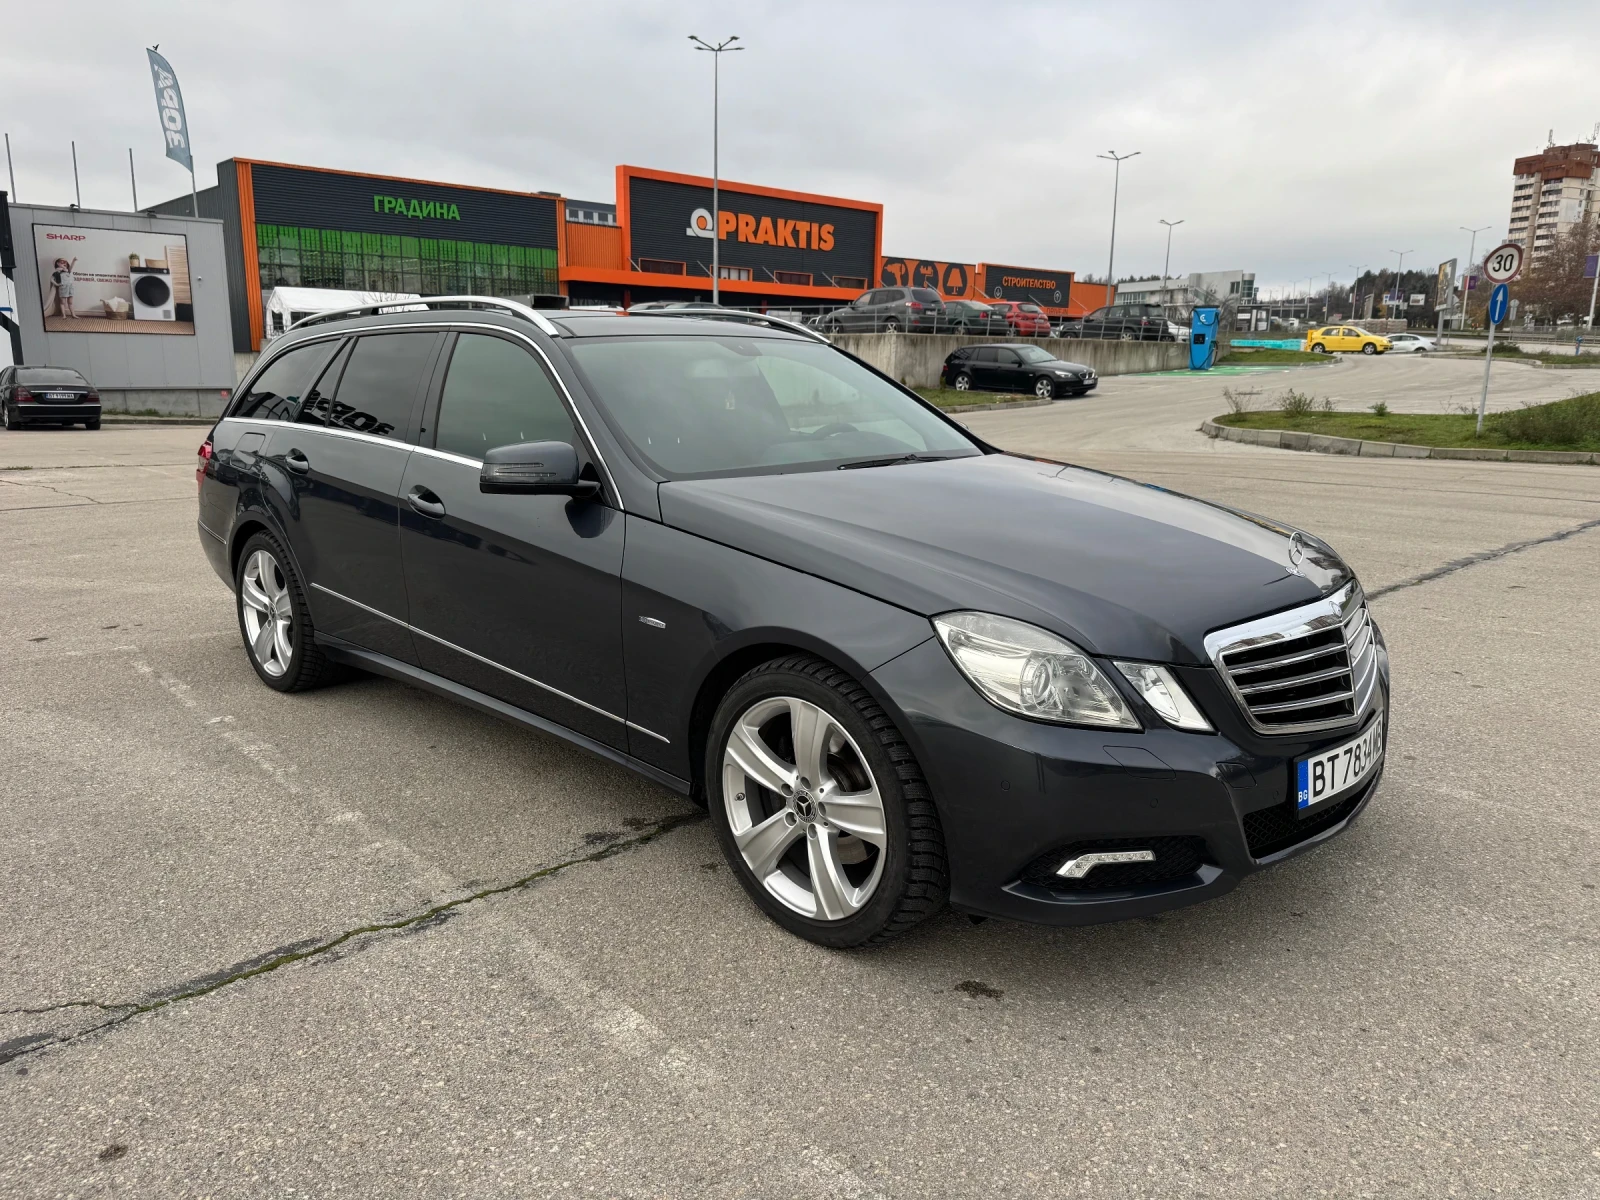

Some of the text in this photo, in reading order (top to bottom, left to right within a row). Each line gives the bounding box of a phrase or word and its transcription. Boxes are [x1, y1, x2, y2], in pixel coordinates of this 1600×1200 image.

[374, 195, 460, 220] ГРАДИНА
[46, 233, 86, 241] SHARP
[718, 211, 835, 251] PRAKTIS
[1493, 254, 1514, 272] 30
[1002, 276, 1056, 290] СТРОИТЕЛСТВО
[1313, 753, 1340, 798] BT
[1298, 790, 1308, 802] BG
